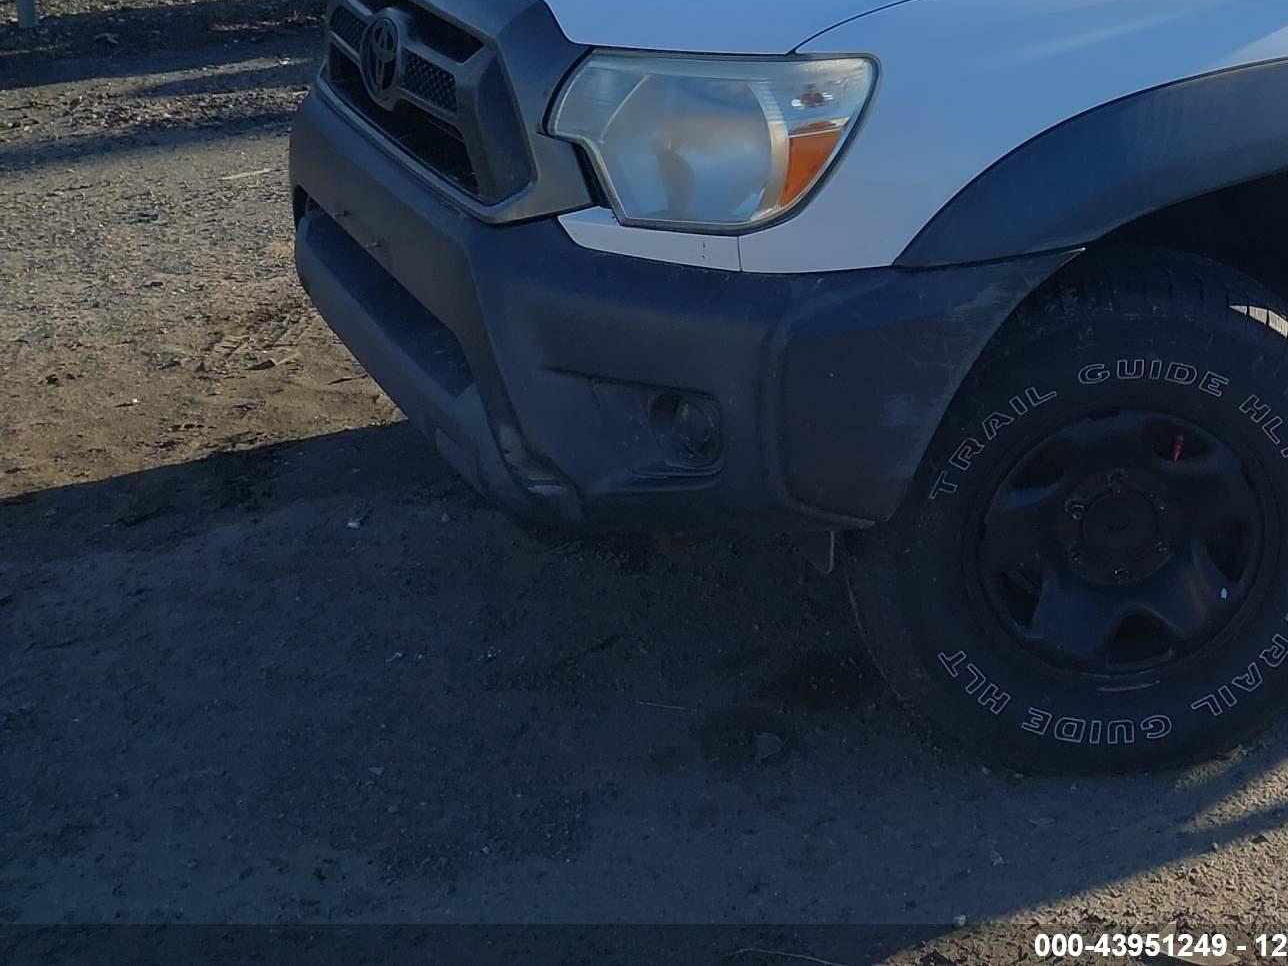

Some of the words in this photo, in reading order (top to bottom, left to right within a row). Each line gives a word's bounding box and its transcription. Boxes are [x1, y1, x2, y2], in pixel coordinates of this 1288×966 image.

[929, 385, 1058, 500] TRAIL
[1078, 359, 1230, 397] GUIDE
[938, 650, 1011, 715] HLT
[1022, 708, 1173, 745] GUIDE
